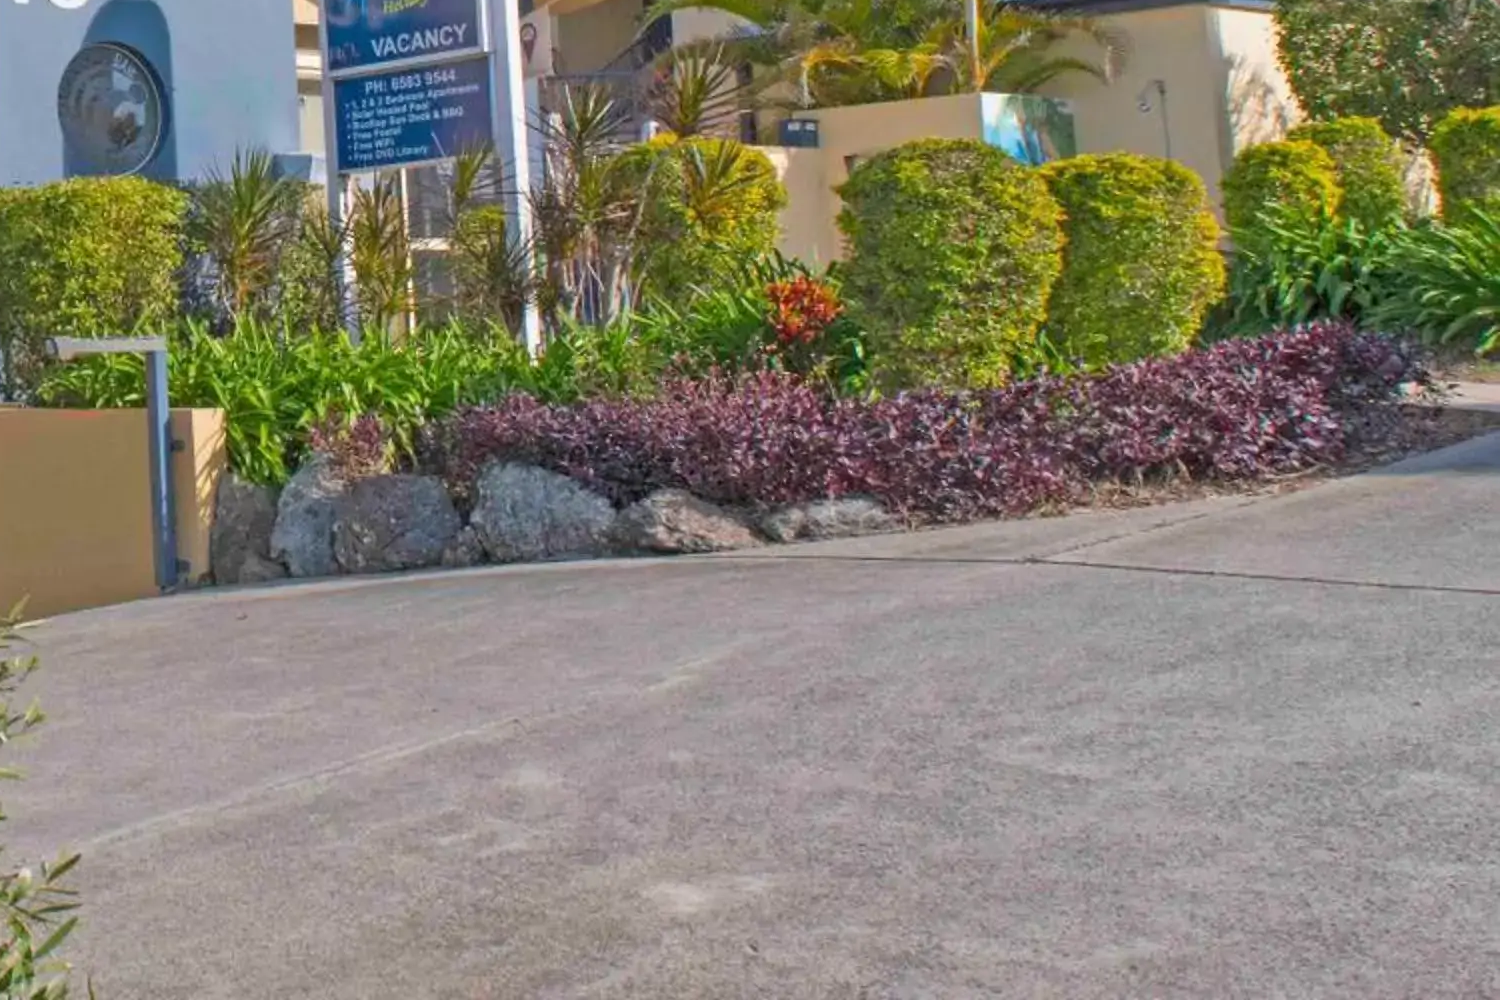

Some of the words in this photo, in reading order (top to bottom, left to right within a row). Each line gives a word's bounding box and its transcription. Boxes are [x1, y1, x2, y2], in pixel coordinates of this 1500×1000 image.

[371, 23, 468, 58] VACANCY
[365, 79, 387, 95] PH:
[385, 91, 425, 105] Bedroom
[427, 84, 480, 98] Apartments
[353, 130, 373, 141] Free
[354, 151, 373, 162] Free
[375, 147, 394, 159] DVD
